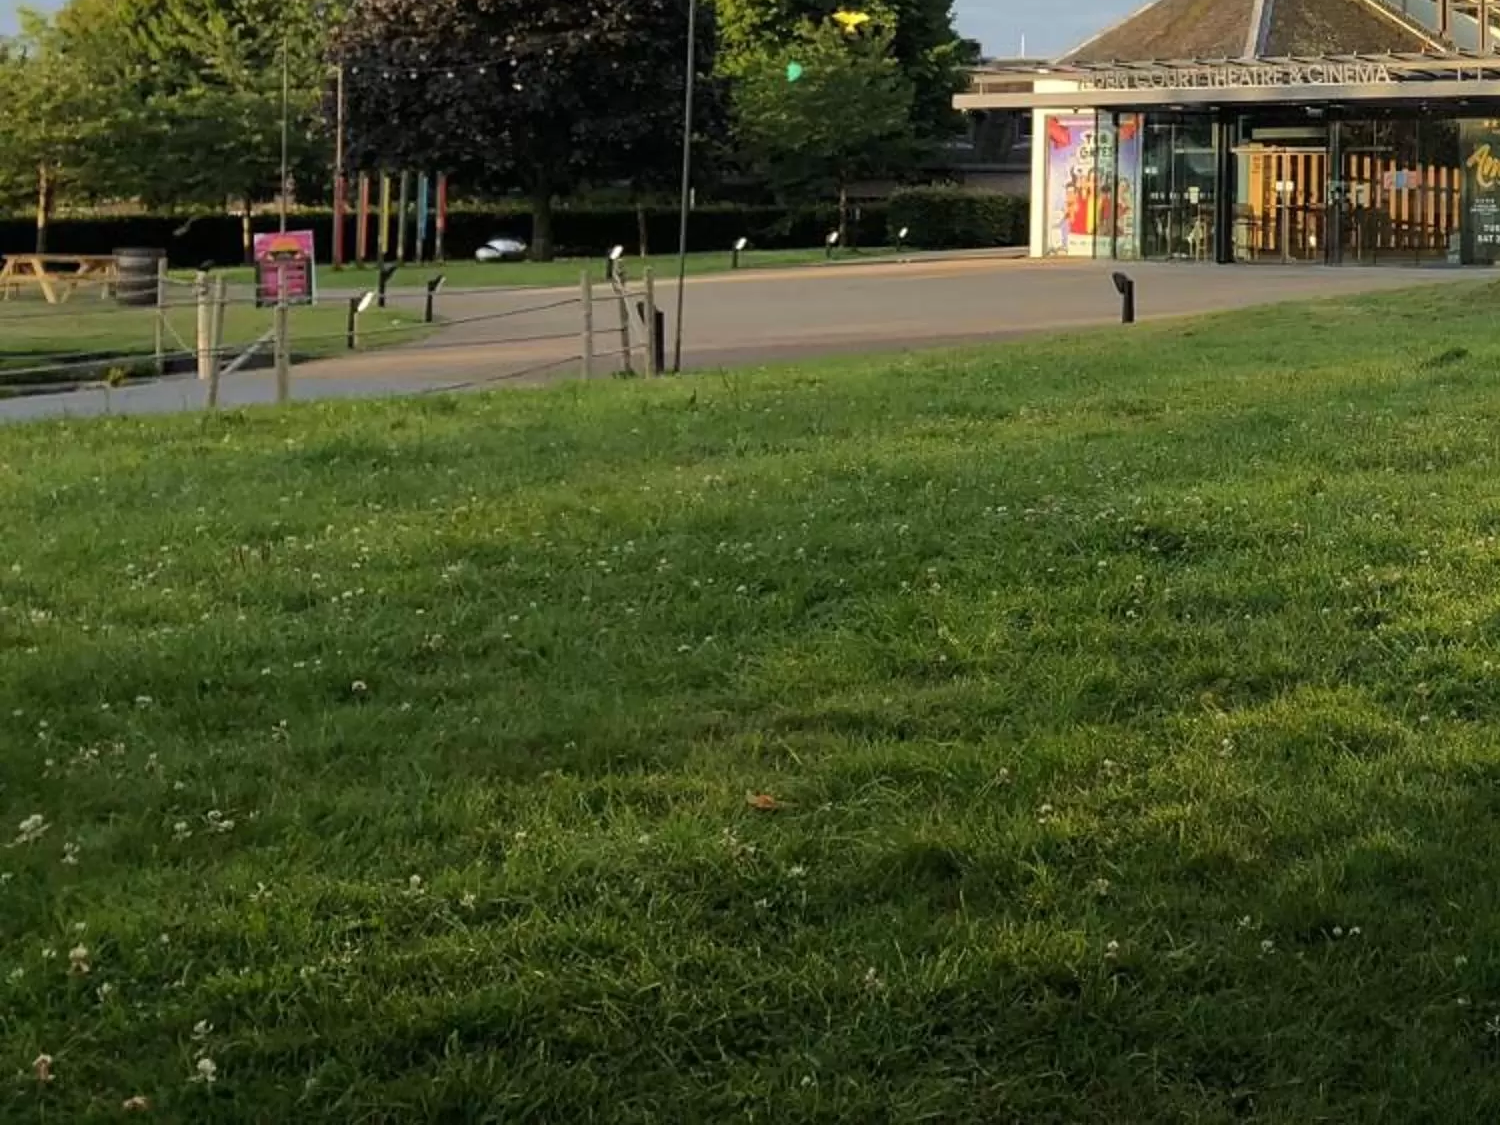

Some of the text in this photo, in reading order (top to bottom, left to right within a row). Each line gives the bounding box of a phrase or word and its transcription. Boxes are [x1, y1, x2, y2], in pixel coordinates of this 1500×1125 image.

[1206, 65, 1284, 87] THEATRE
[1289, 65, 1304, 84] &
[1308, 63, 1391, 84] CINEMA
